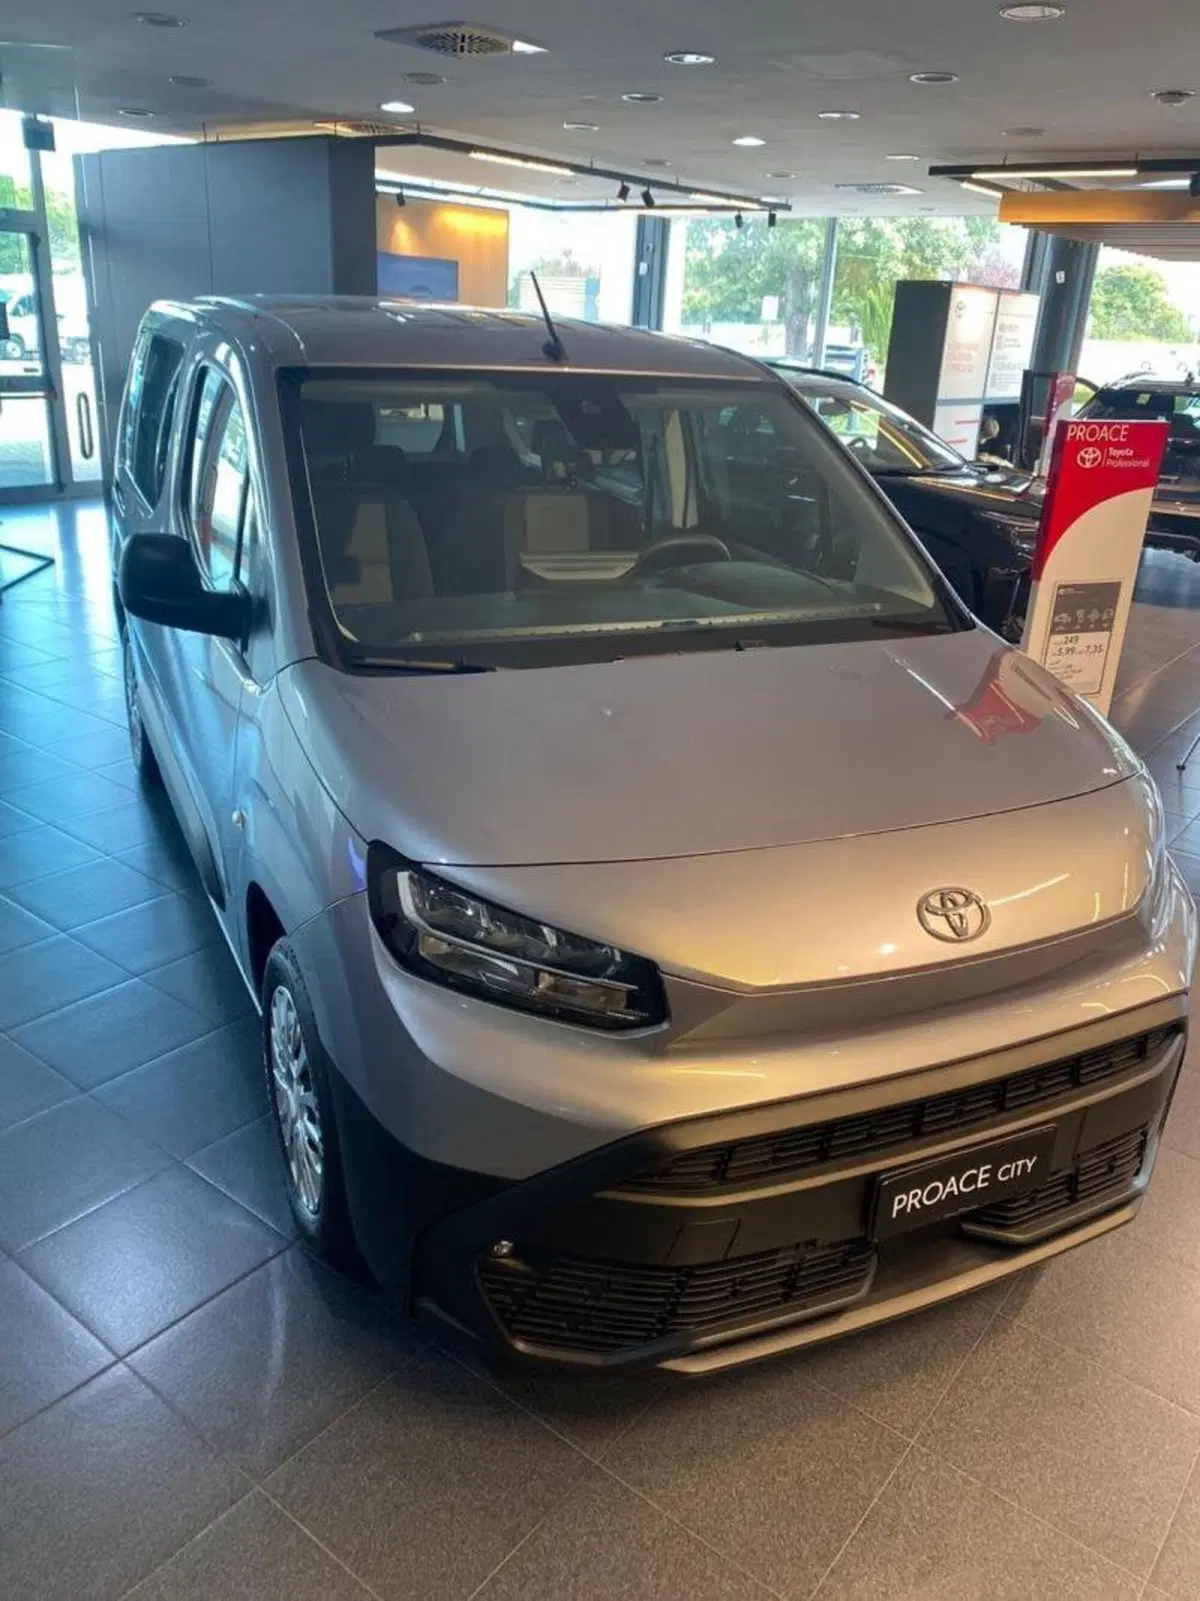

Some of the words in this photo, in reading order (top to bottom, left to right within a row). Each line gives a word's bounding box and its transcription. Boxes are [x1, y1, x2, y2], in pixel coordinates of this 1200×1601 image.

[1066, 424, 1129, 442] PROACE
[1109, 447, 1134, 458] Toyota
[891, 1164, 992, 1219] PROACE
[997, 1155, 1038, 1182] CITY
